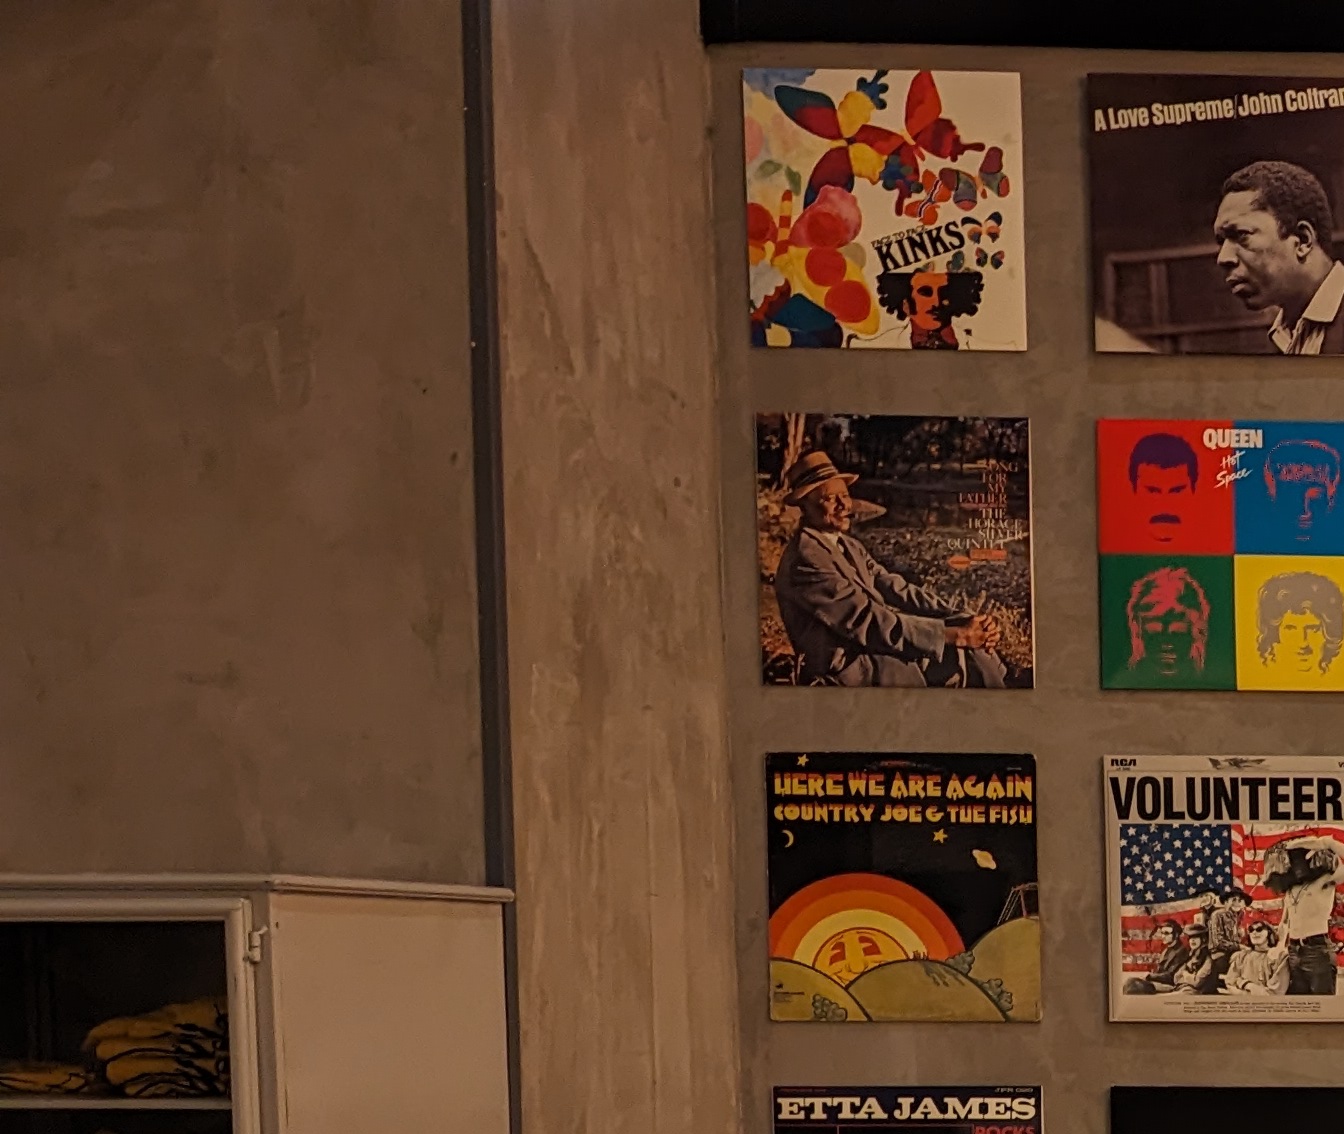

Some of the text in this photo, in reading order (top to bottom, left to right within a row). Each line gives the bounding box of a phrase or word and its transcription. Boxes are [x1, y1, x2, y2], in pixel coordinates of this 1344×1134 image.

[1094, 109, 1106, 131] A
[1108, 107, 1149, 129] Love
[874, 221, 965, 271] KINKS
[1203, 428, 1263, 449] QUEEN
[1219, 450, 1246, 469] Hot
[1214, 469, 1253, 488] Space
[1111, 758, 1136, 766] RCA
[774, 771, 1033, 802] HERE WE ARE AGAIN
[774, 803, 874, 823] COUNTRY
[880, 804, 922, 823] JOE
[946, 804, 985, 824] THE
[990, 805, 1033, 825] FISH
[777, 1097, 1036, 1120] ETTA JAMES
